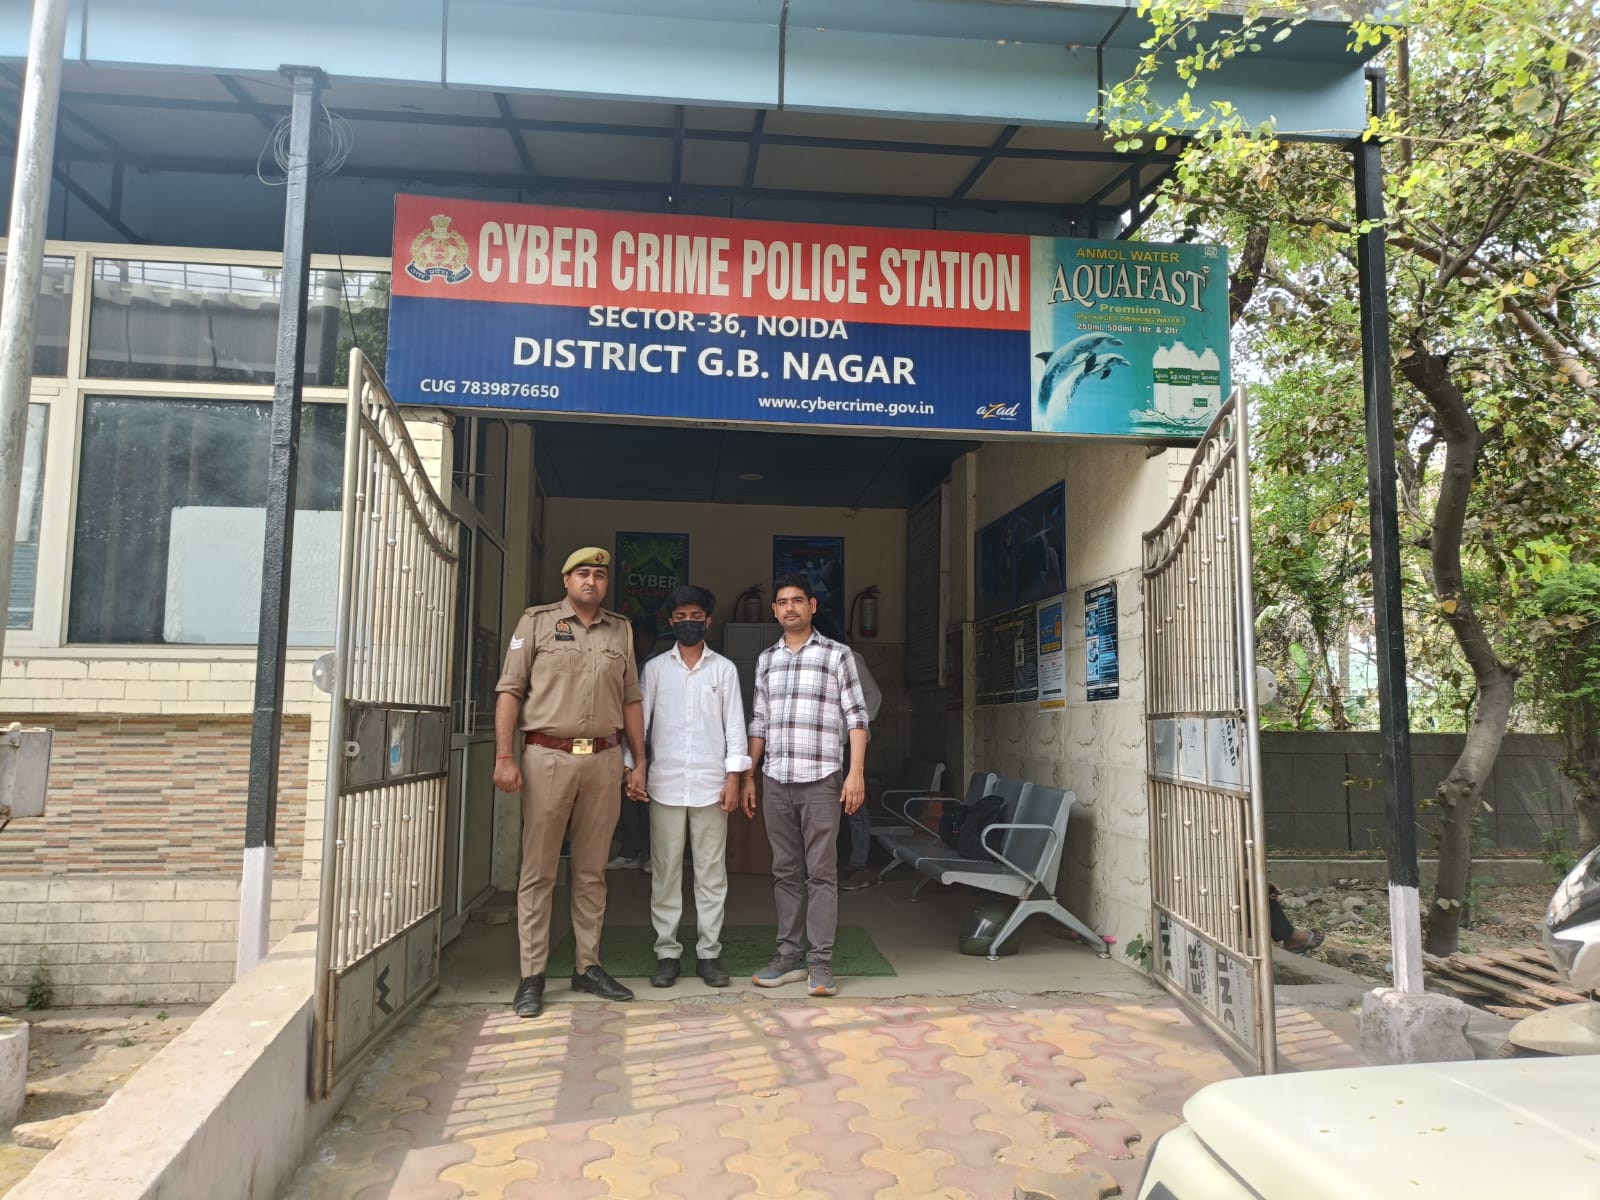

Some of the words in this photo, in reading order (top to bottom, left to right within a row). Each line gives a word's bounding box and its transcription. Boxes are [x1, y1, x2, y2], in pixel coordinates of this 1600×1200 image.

[1076, 247, 1127, 261] ANMOL
[1130, 251, 1180, 263] WATER
[478, 221, 598, 289] CYBER
[611, 230, 730, 297] CRIME
[742, 239, 868, 304] POLICE
[879, 247, 1020, 312] STATION
[1047, 263, 1208, 312] AQUAFAST
[1099, 303, 1161, 315] Premium
[588, 304, 747, 338] SECTOR-36,
[756, 315, 849, 340] NOIDA
[1119, 315, 1155, 323] DRINKING
[1155, 317, 1181, 325] WATER
[1155, 326, 1162, 334] &
[512, 336, 687, 374] DISTRICT
[697, 347, 769, 379] G.B.
[782, 351, 917, 385] NAGAR
[419, 378, 456, 394] CUG
[460, 380, 560, 399] 7839876650
[758, 396, 934, 416] www.cybercrime.gov.in
[627, 573, 678, 589] CYBER
